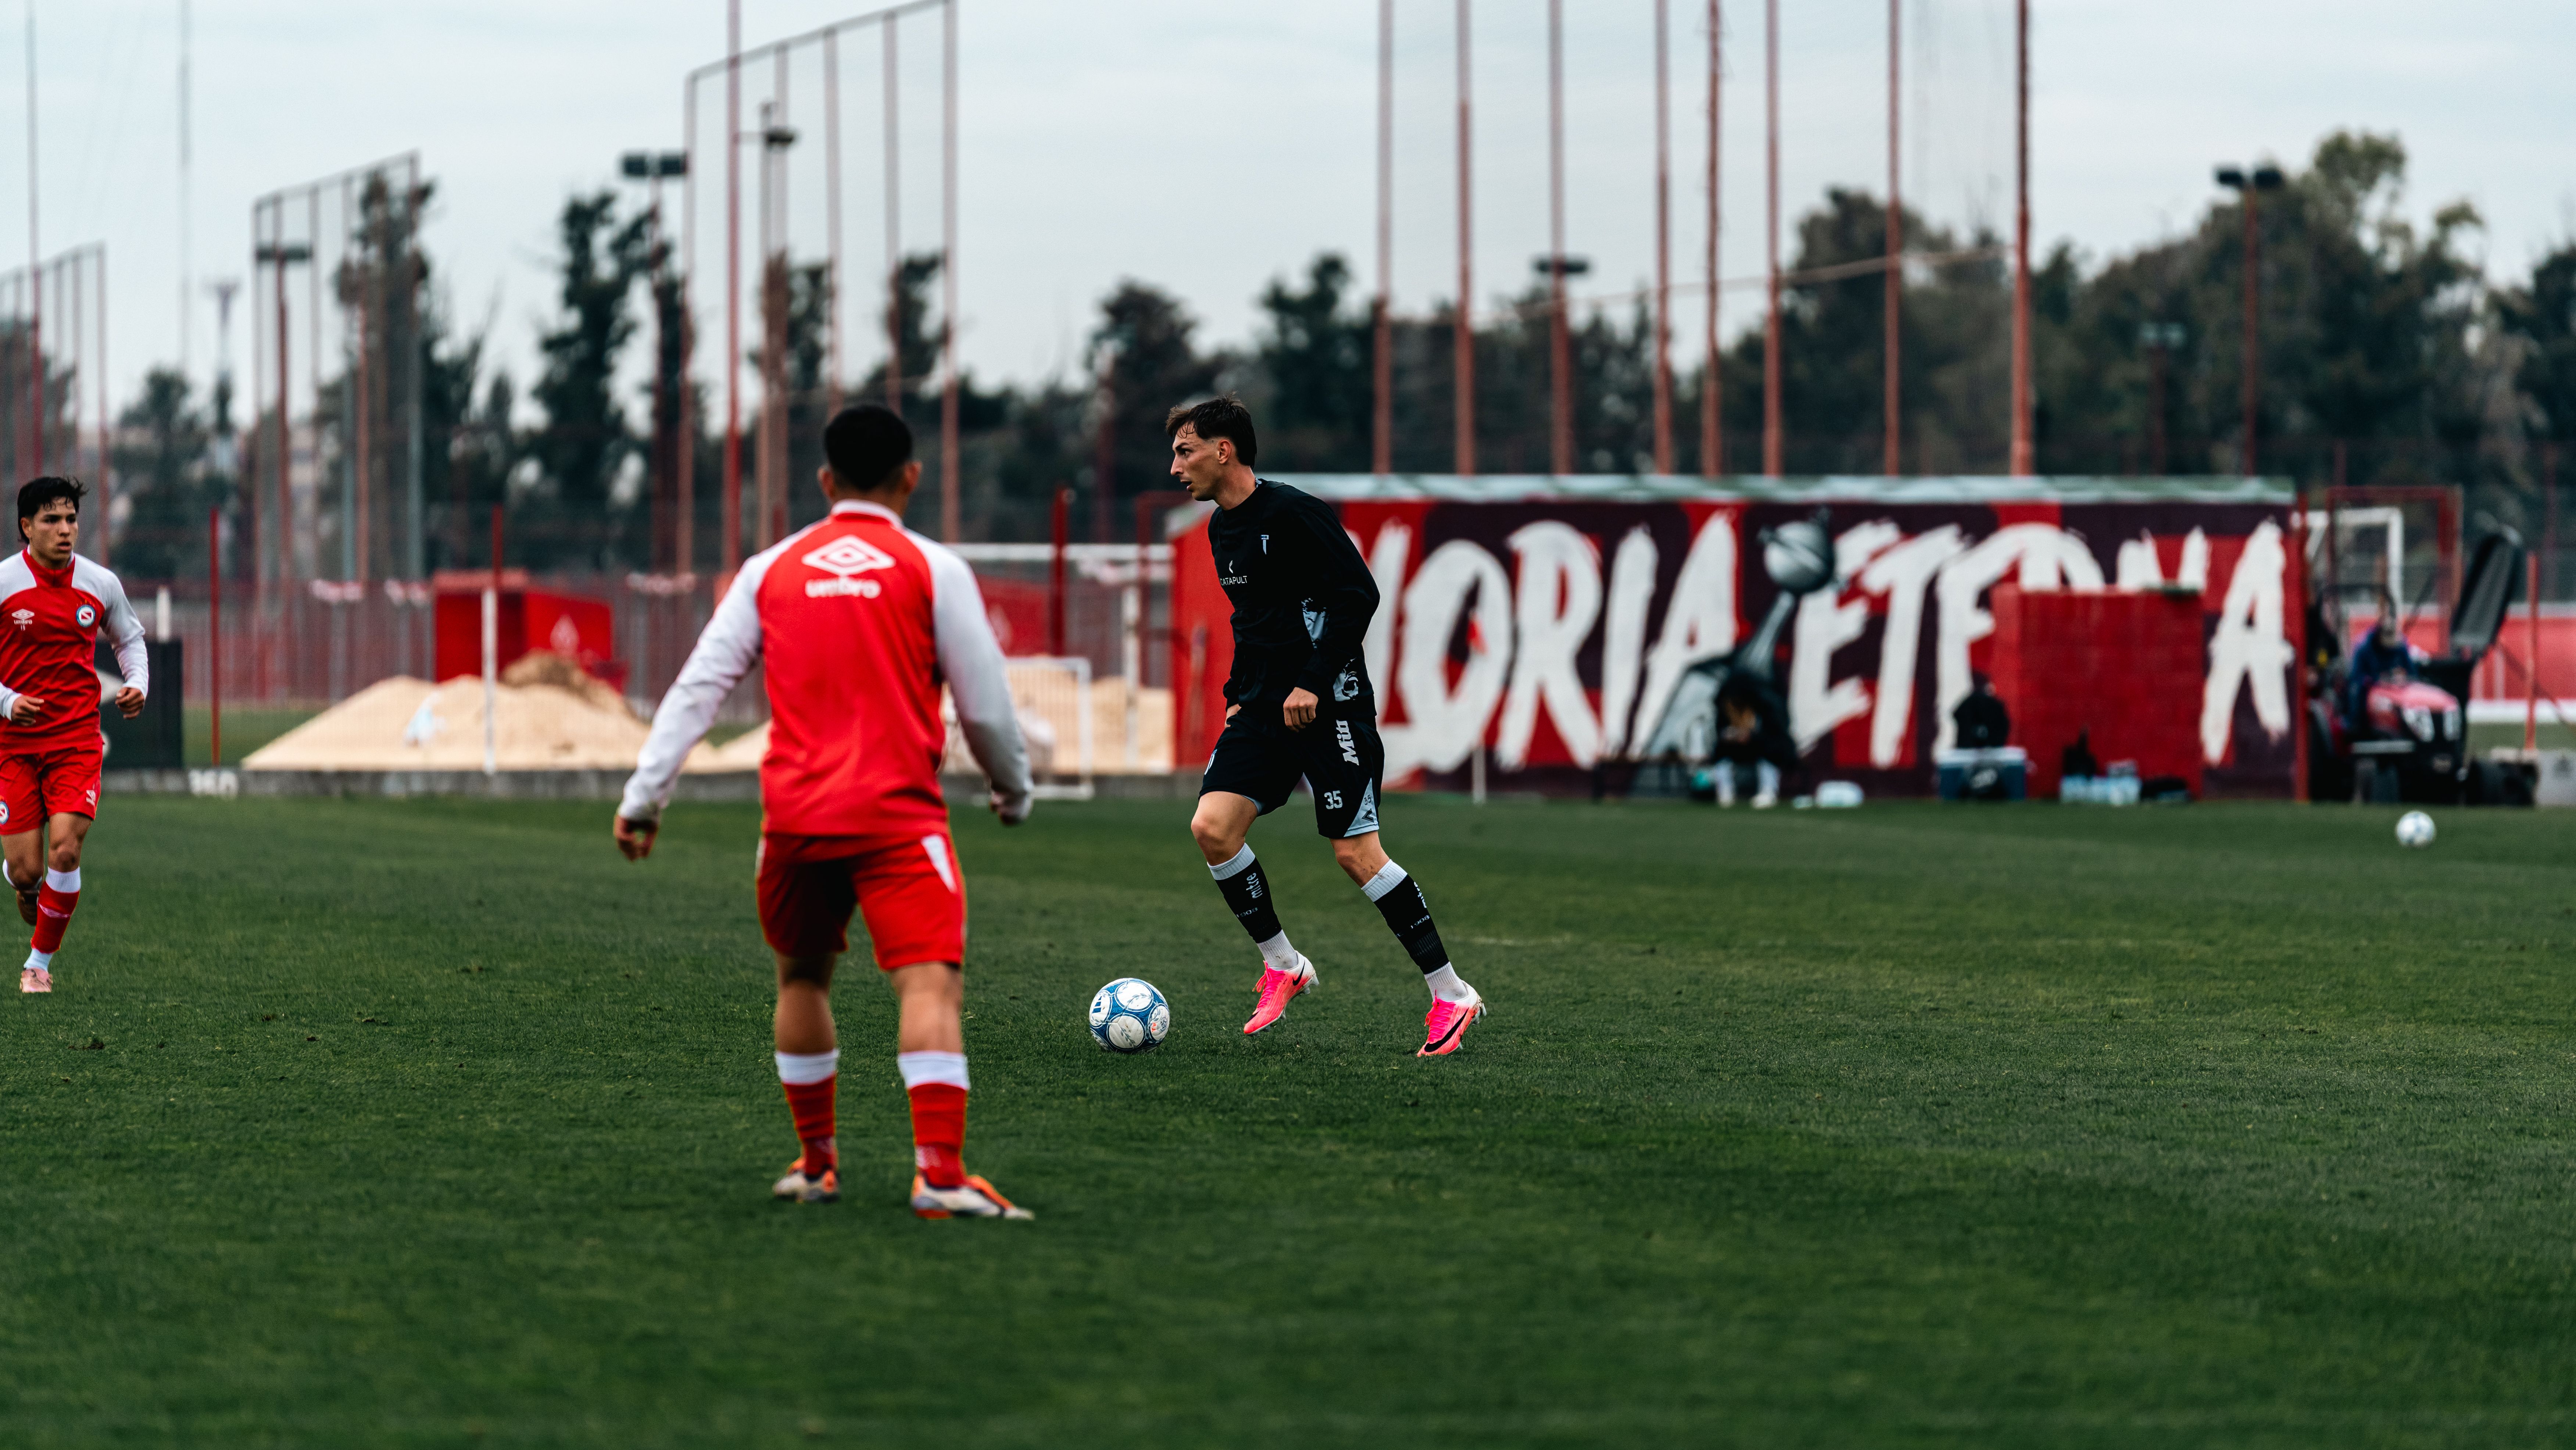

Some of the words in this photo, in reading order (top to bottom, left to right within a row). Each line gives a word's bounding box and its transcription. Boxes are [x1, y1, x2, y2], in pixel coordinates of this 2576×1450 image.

[805, 576, 882, 599] umbro
[1220, 575, 1247, 586] CATAPULT
[1345, 510, 1738, 789] LORIA
[1324, 790, 1342, 809] 35
[1364, 794, 1372, 805] 35
[1246, 873, 1263, 899] mitre
